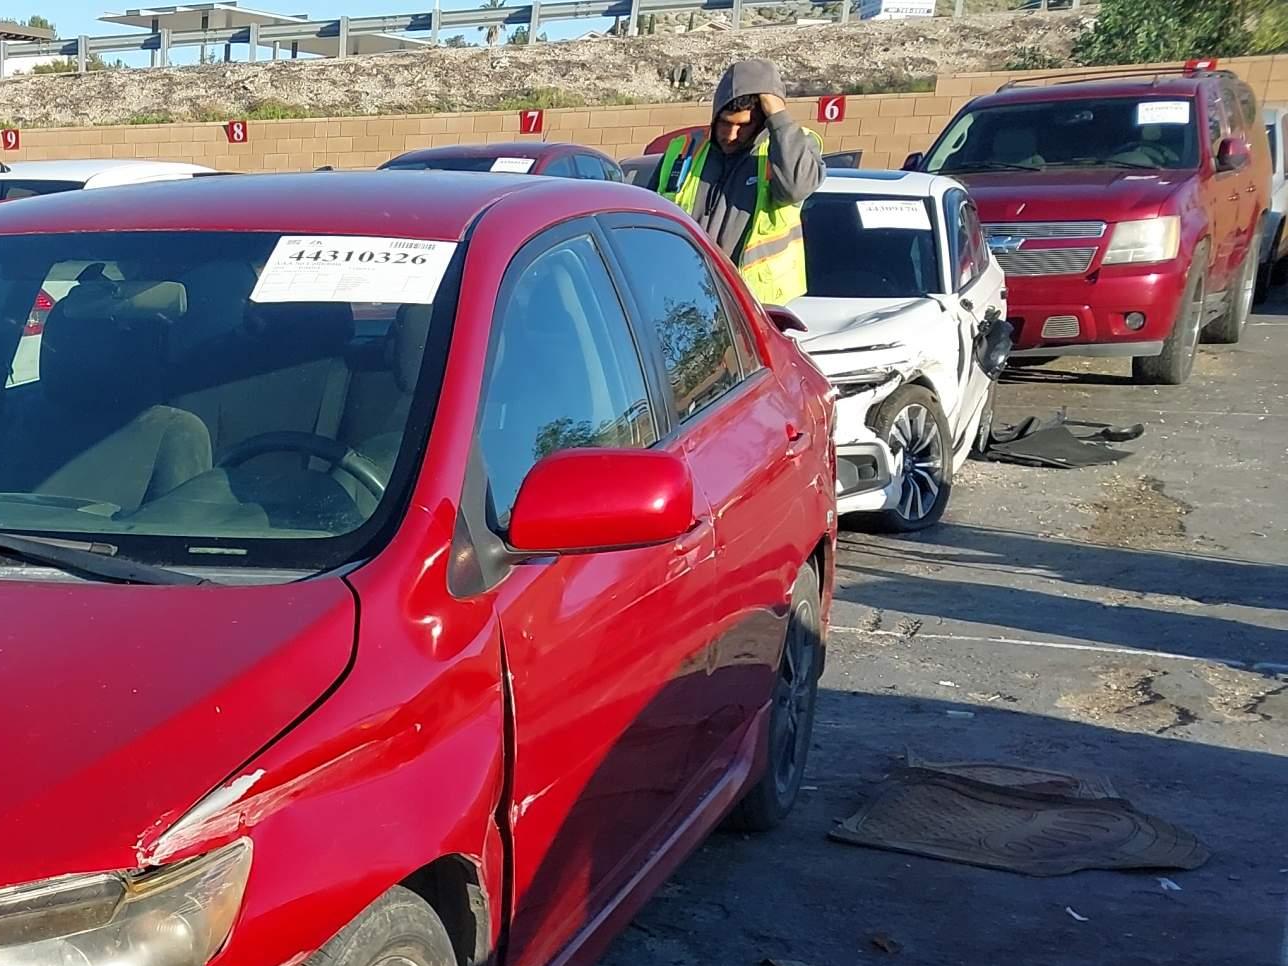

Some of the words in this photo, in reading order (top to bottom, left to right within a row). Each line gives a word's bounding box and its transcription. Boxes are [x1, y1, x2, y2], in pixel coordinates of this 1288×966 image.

[824, 97, 839, 120] 6
[526, 111, 539, 132] 7
[7, 131, 16, 149] 9
[233, 122, 244, 141] 8
[289, 249, 427, 265] 44310326
